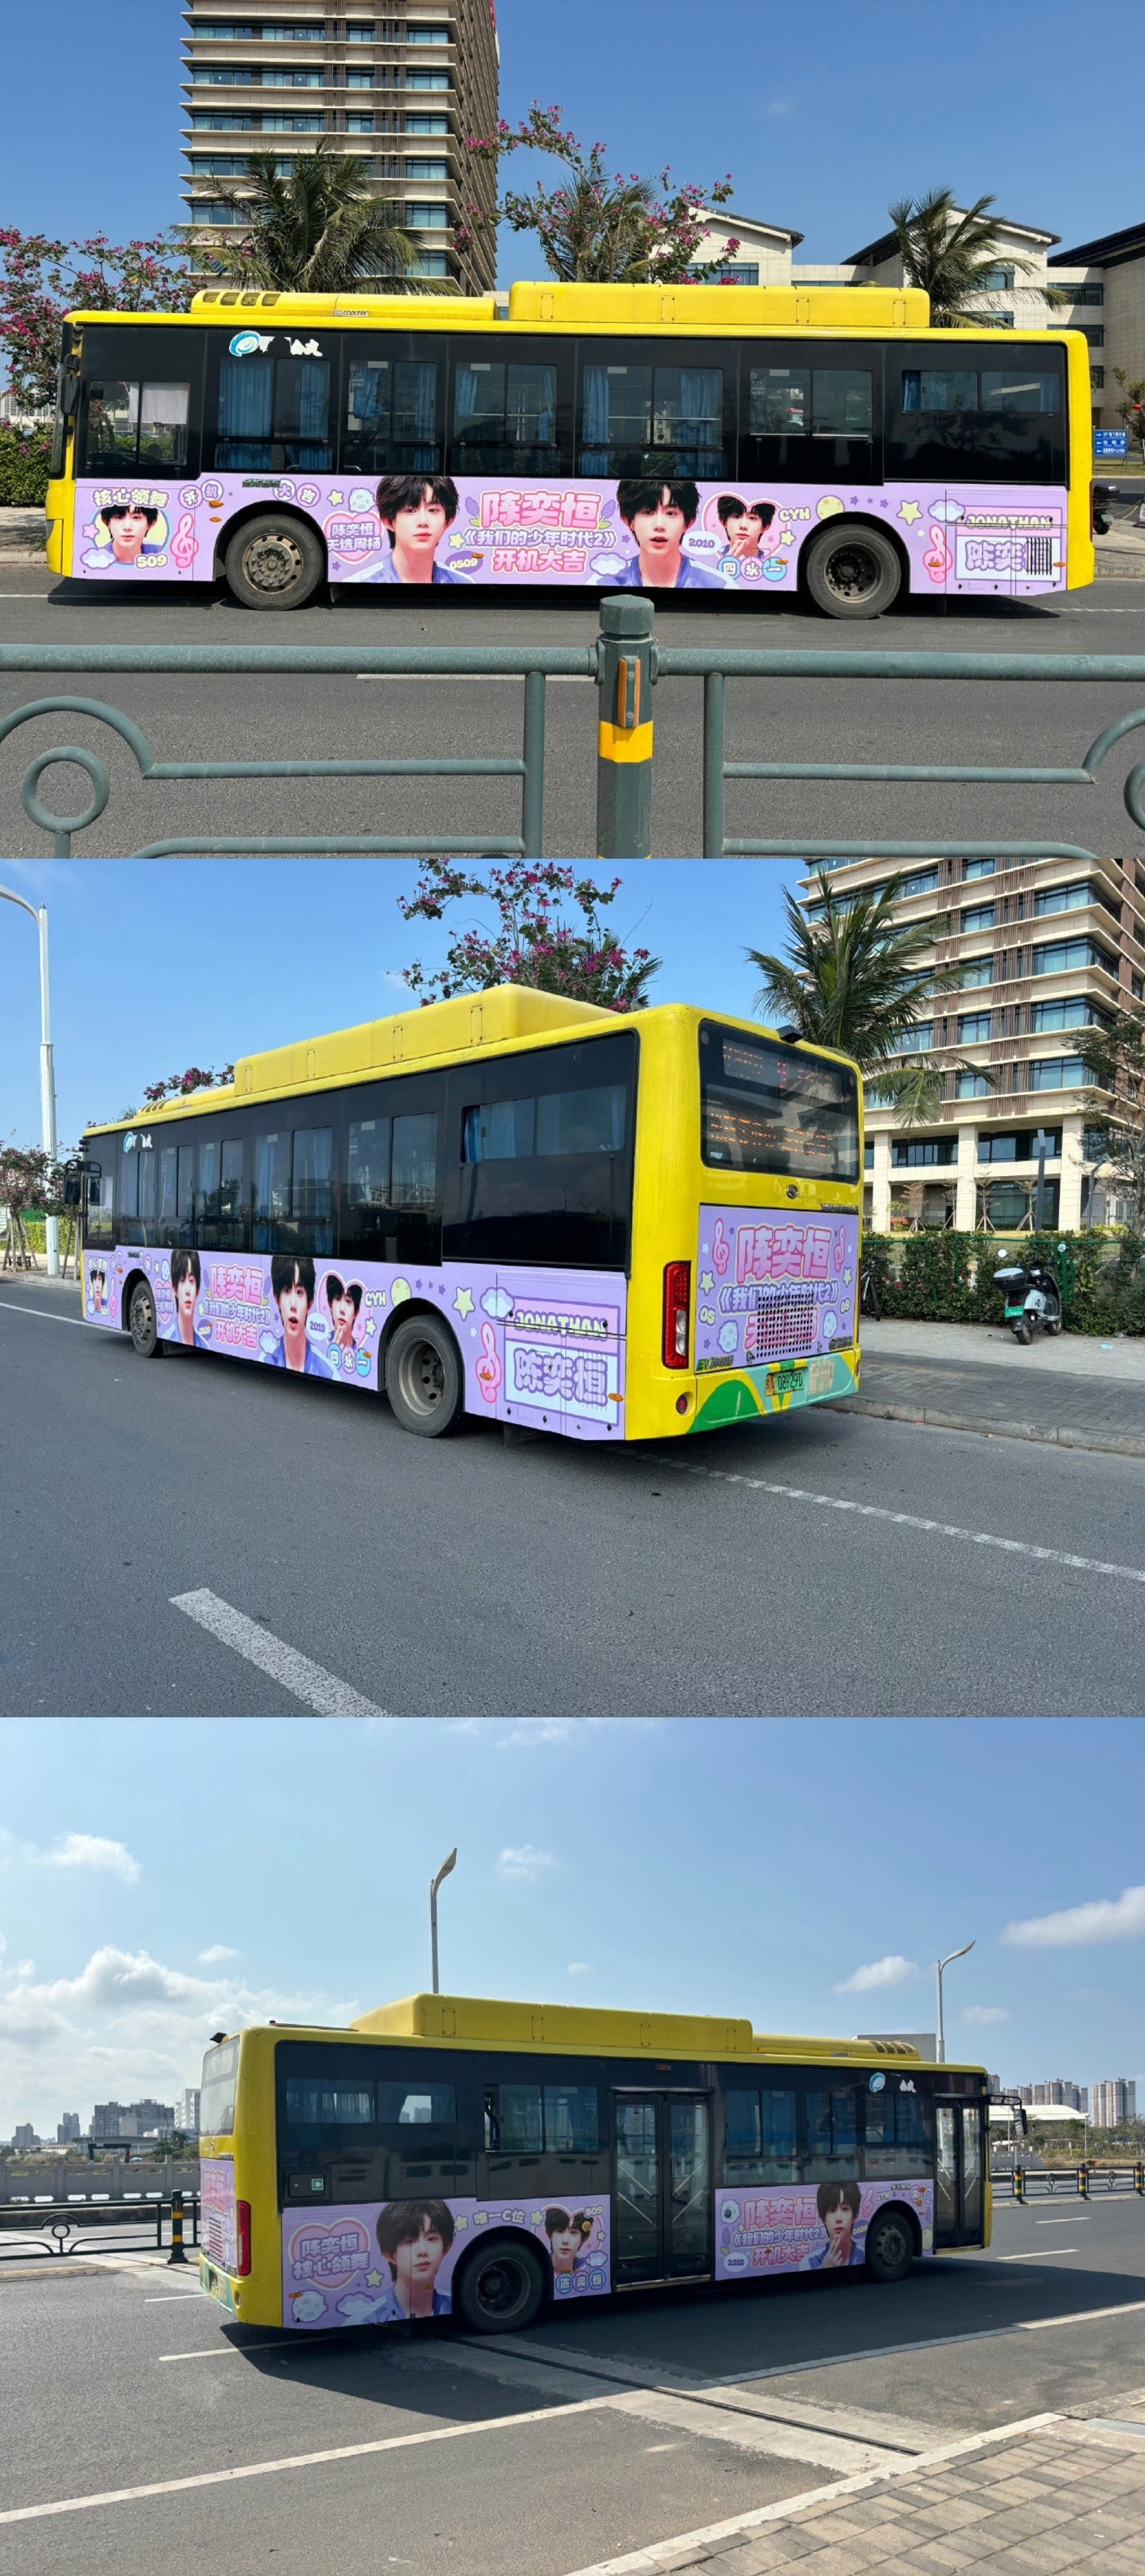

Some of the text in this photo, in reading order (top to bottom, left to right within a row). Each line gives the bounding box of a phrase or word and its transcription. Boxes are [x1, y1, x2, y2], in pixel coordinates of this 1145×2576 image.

[92, 489, 169, 507] 核心领舞
[779, 507, 810, 522] CYH
[965, 514, 1053, 531] JONATHAN
[464, 529, 617, 547] 《我们的少年时代2》
[688, 537, 716, 549] 2010
[135, 554, 168, 569] 509
[449, 558, 478, 570] 0509
[492, 548, 587, 572] 开机大吉
[365, 1290, 387, 1308] CYH
[204, 1299, 271, 1326] 《我们的少年时代2》
[699, 1306, 716, 1325] 05
[216, 1319, 258, 1349] 开机大吉
[309, 1321, 326, 1333] 2010
[515, 1309, 608, 1341] JONATHAN
[514, 1348, 608, 1407] 陈奕恒
[473, 2208, 526, 2226] 唯一C位
[584, 2205, 604, 2218] 509
[733, 2226, 827, 2248] 《我们的少年时代2》
[292, 2251, 370, 2281] 核心领舞
[727, 2259, 745, 2267] 2010
